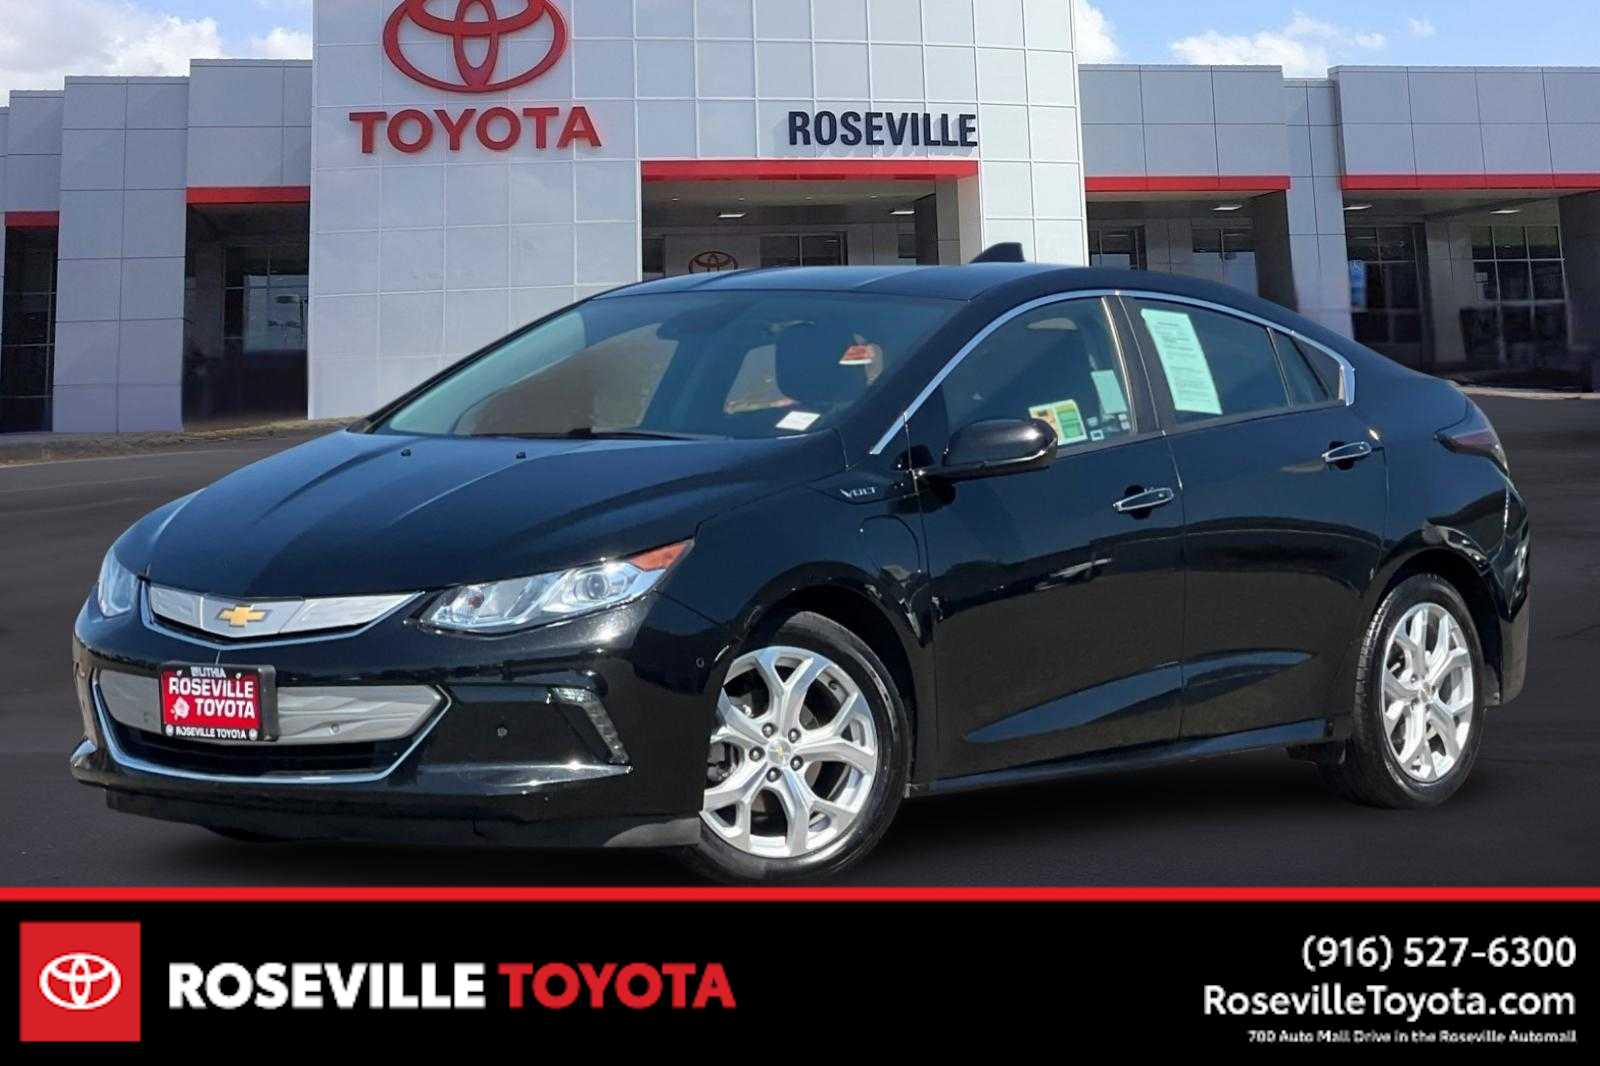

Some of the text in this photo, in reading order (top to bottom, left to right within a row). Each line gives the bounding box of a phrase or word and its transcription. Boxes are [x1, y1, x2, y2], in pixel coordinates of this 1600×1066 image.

[349, 106, 602, 154] TOYOTA
[788, 110, 978, 147] ROSEVILLE
[840, 486, 876, 498] VOLT
[168, 677, 255, 698] ROSEVILLE
[194, 698, 256, 719] TOYOTA
[175, 726, 247, 739] ROSEVILLE TOYOTA
